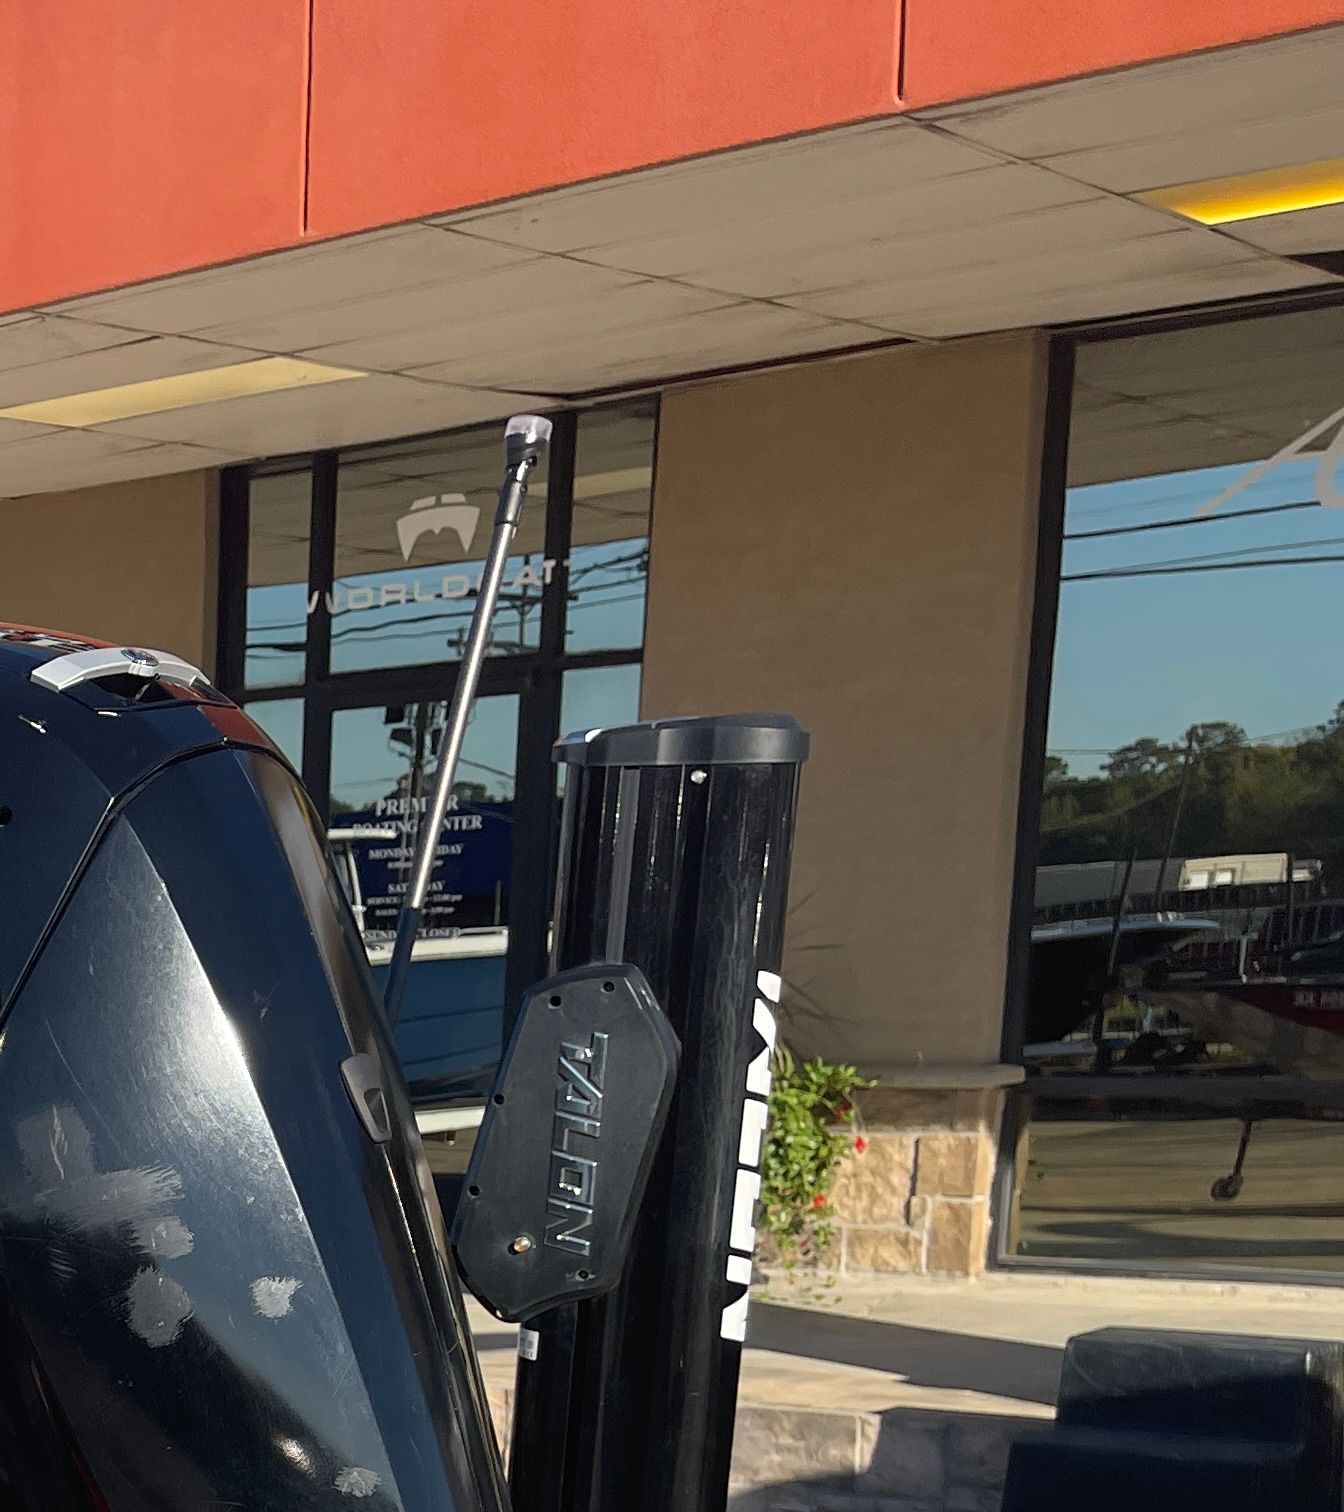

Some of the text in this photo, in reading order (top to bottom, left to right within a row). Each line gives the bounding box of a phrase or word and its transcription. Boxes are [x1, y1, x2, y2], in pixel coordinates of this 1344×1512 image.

[374, 794, 459, 817] PREMR
[426, 814, 483, 832] NTER
[543, 1032, 609, 1257] TALON
